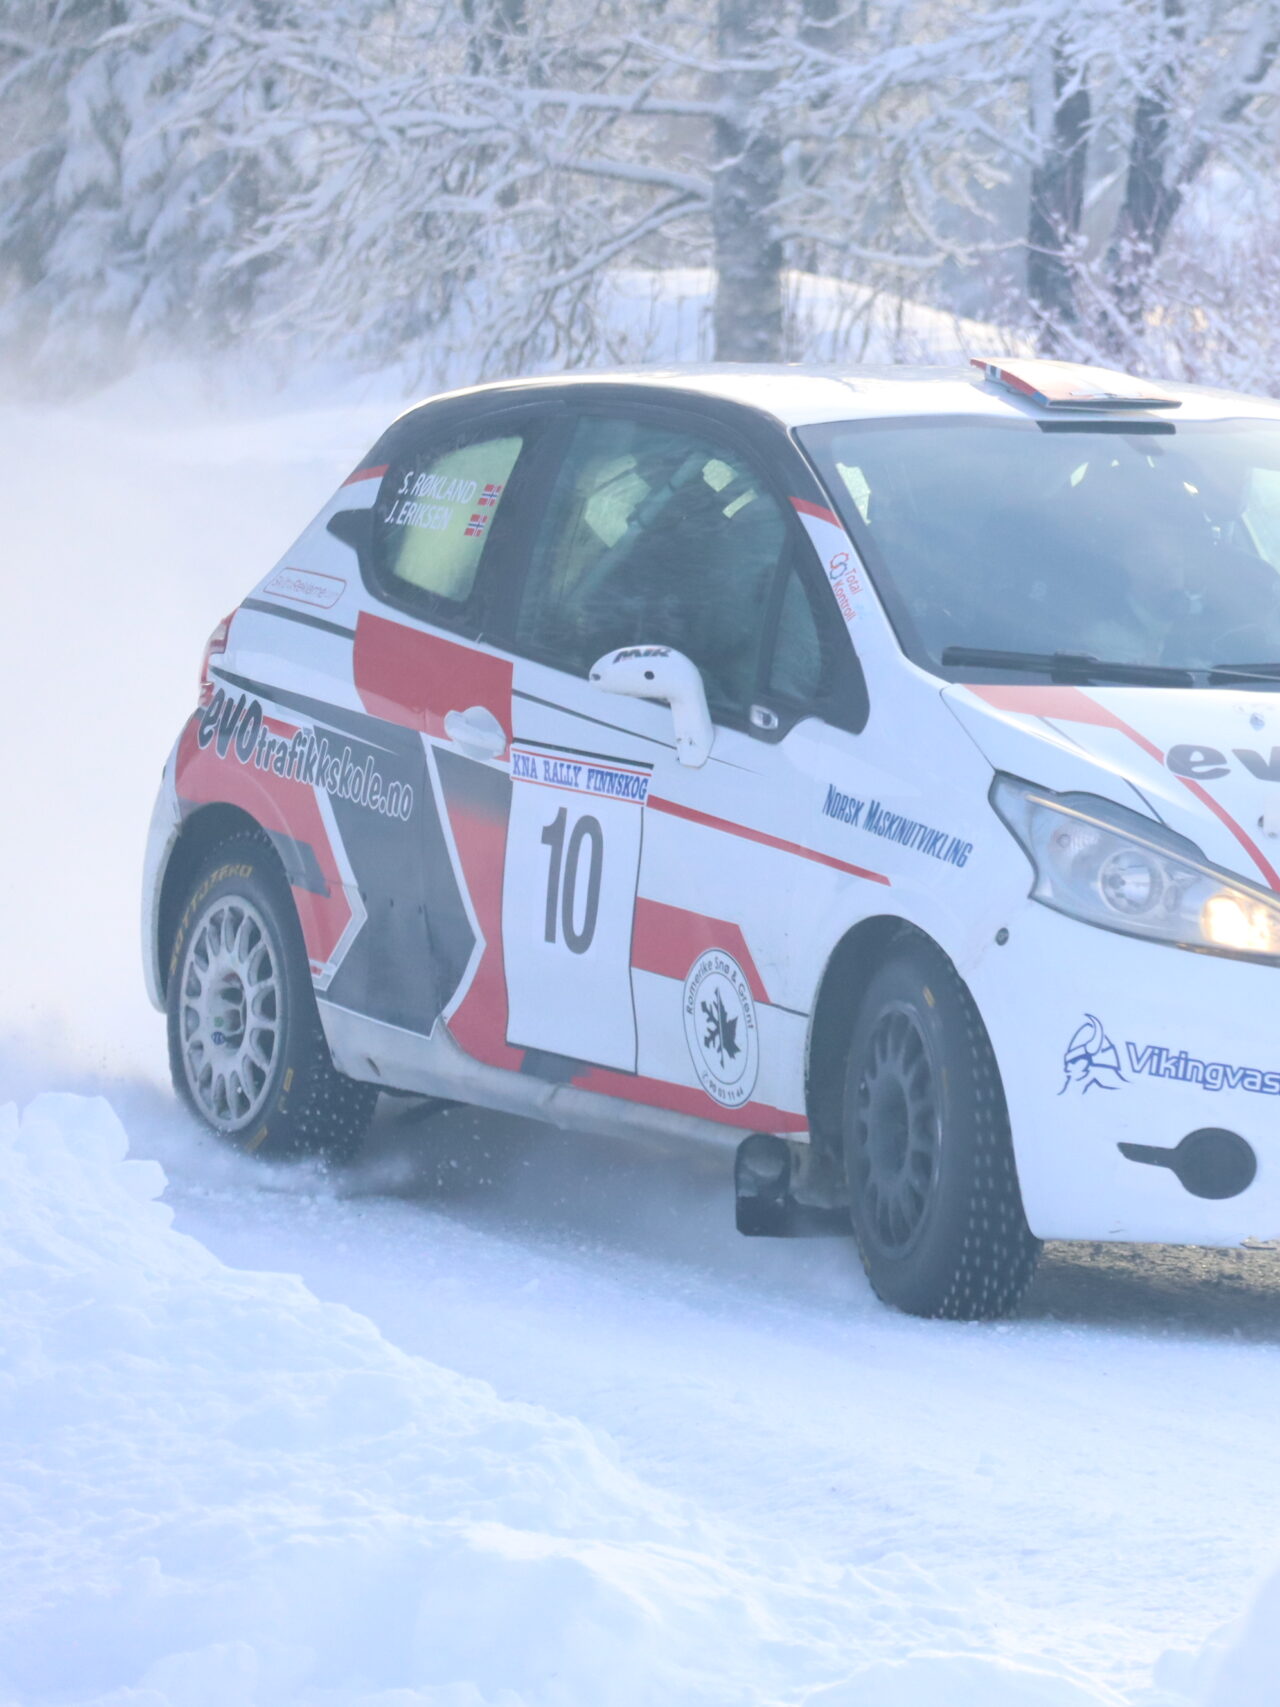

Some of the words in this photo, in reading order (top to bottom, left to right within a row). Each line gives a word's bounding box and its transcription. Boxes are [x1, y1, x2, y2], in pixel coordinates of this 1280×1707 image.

[397, 471, 415, 495] S.
[410, 472, 478, 505] RØKLAND
[384, 499, 400, 523] J.
[396, 501, 453, 530] ERIKSEN
[832, 580, 857, 622] Kontroll
[844, 567, 864, 596] Total
[512, 753, 539, 780] KNA
[543, 760, 582, 788] RALLY
[586, 767, 649, 801] FINNSKOG
[540, 806, 604, 955] 10
[686, 960, 714, 1015] Romerike
